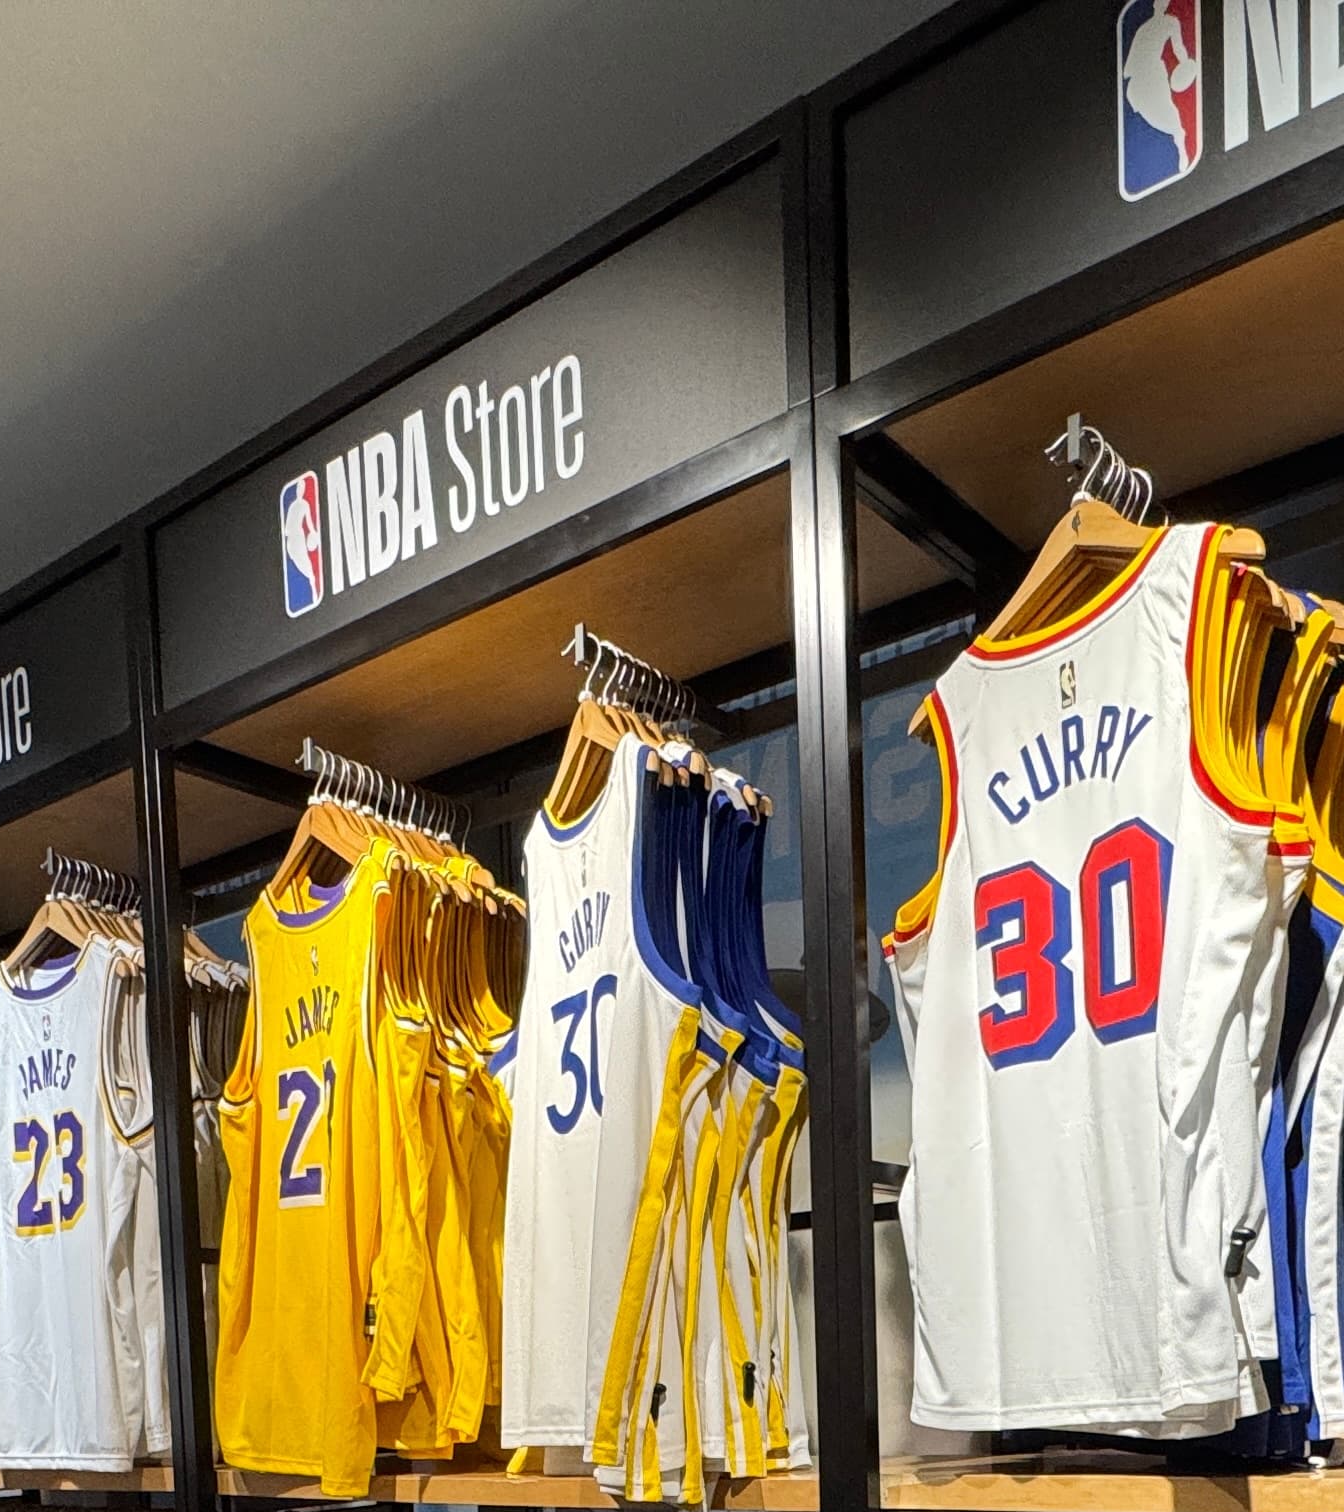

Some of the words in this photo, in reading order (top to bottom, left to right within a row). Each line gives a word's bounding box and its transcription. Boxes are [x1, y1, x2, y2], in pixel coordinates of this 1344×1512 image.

[325, 409, 438, 596] NBA
[444, 354, 585, 534] Store
[987, 704, 1154, 825] CURRY
[974, 816, 1175, 1072] 30
[16, 1047, 77, 1100] JAMES
[12, 1106, 90, 1238] 23
